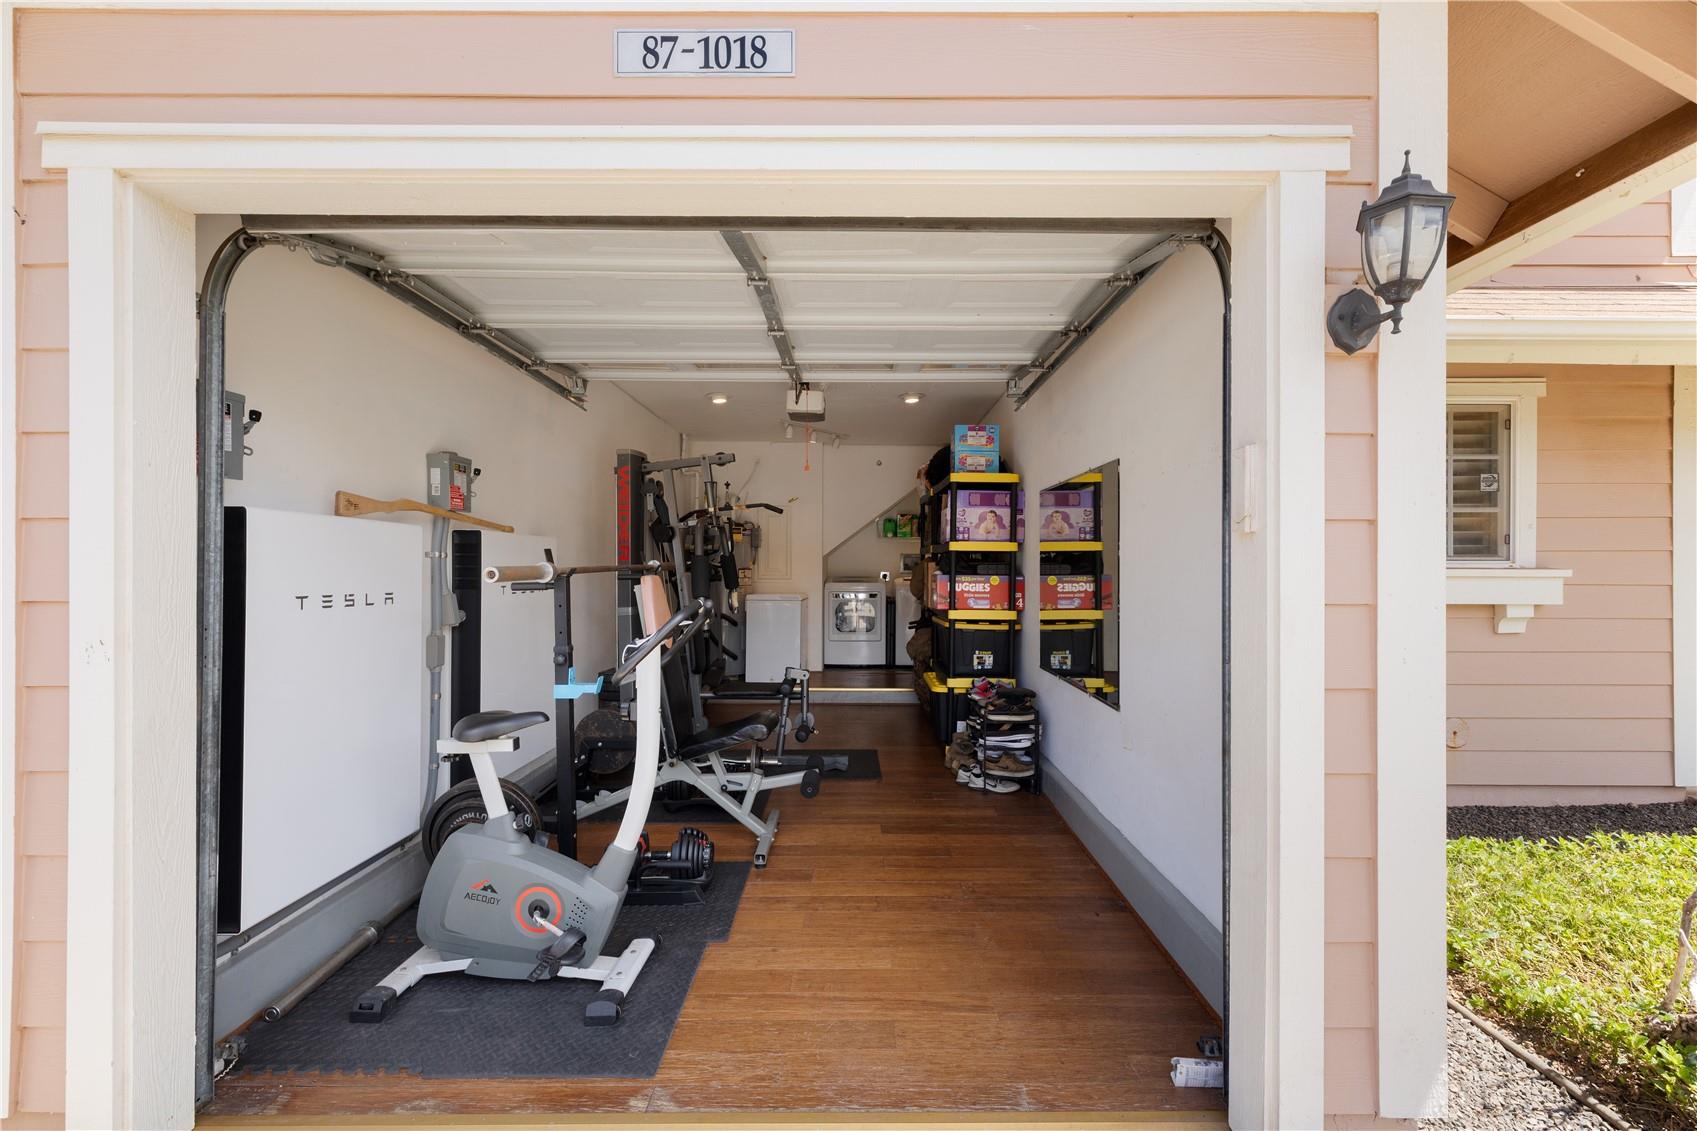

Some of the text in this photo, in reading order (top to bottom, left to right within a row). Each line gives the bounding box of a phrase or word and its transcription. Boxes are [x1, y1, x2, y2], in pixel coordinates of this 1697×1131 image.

[642, 35, 768, 69] 87-1018
[947, 582, 991, 593] UGGIES
[295, 592, 394, 610] TESLA
[1016, 598, 1024, 608] 4
